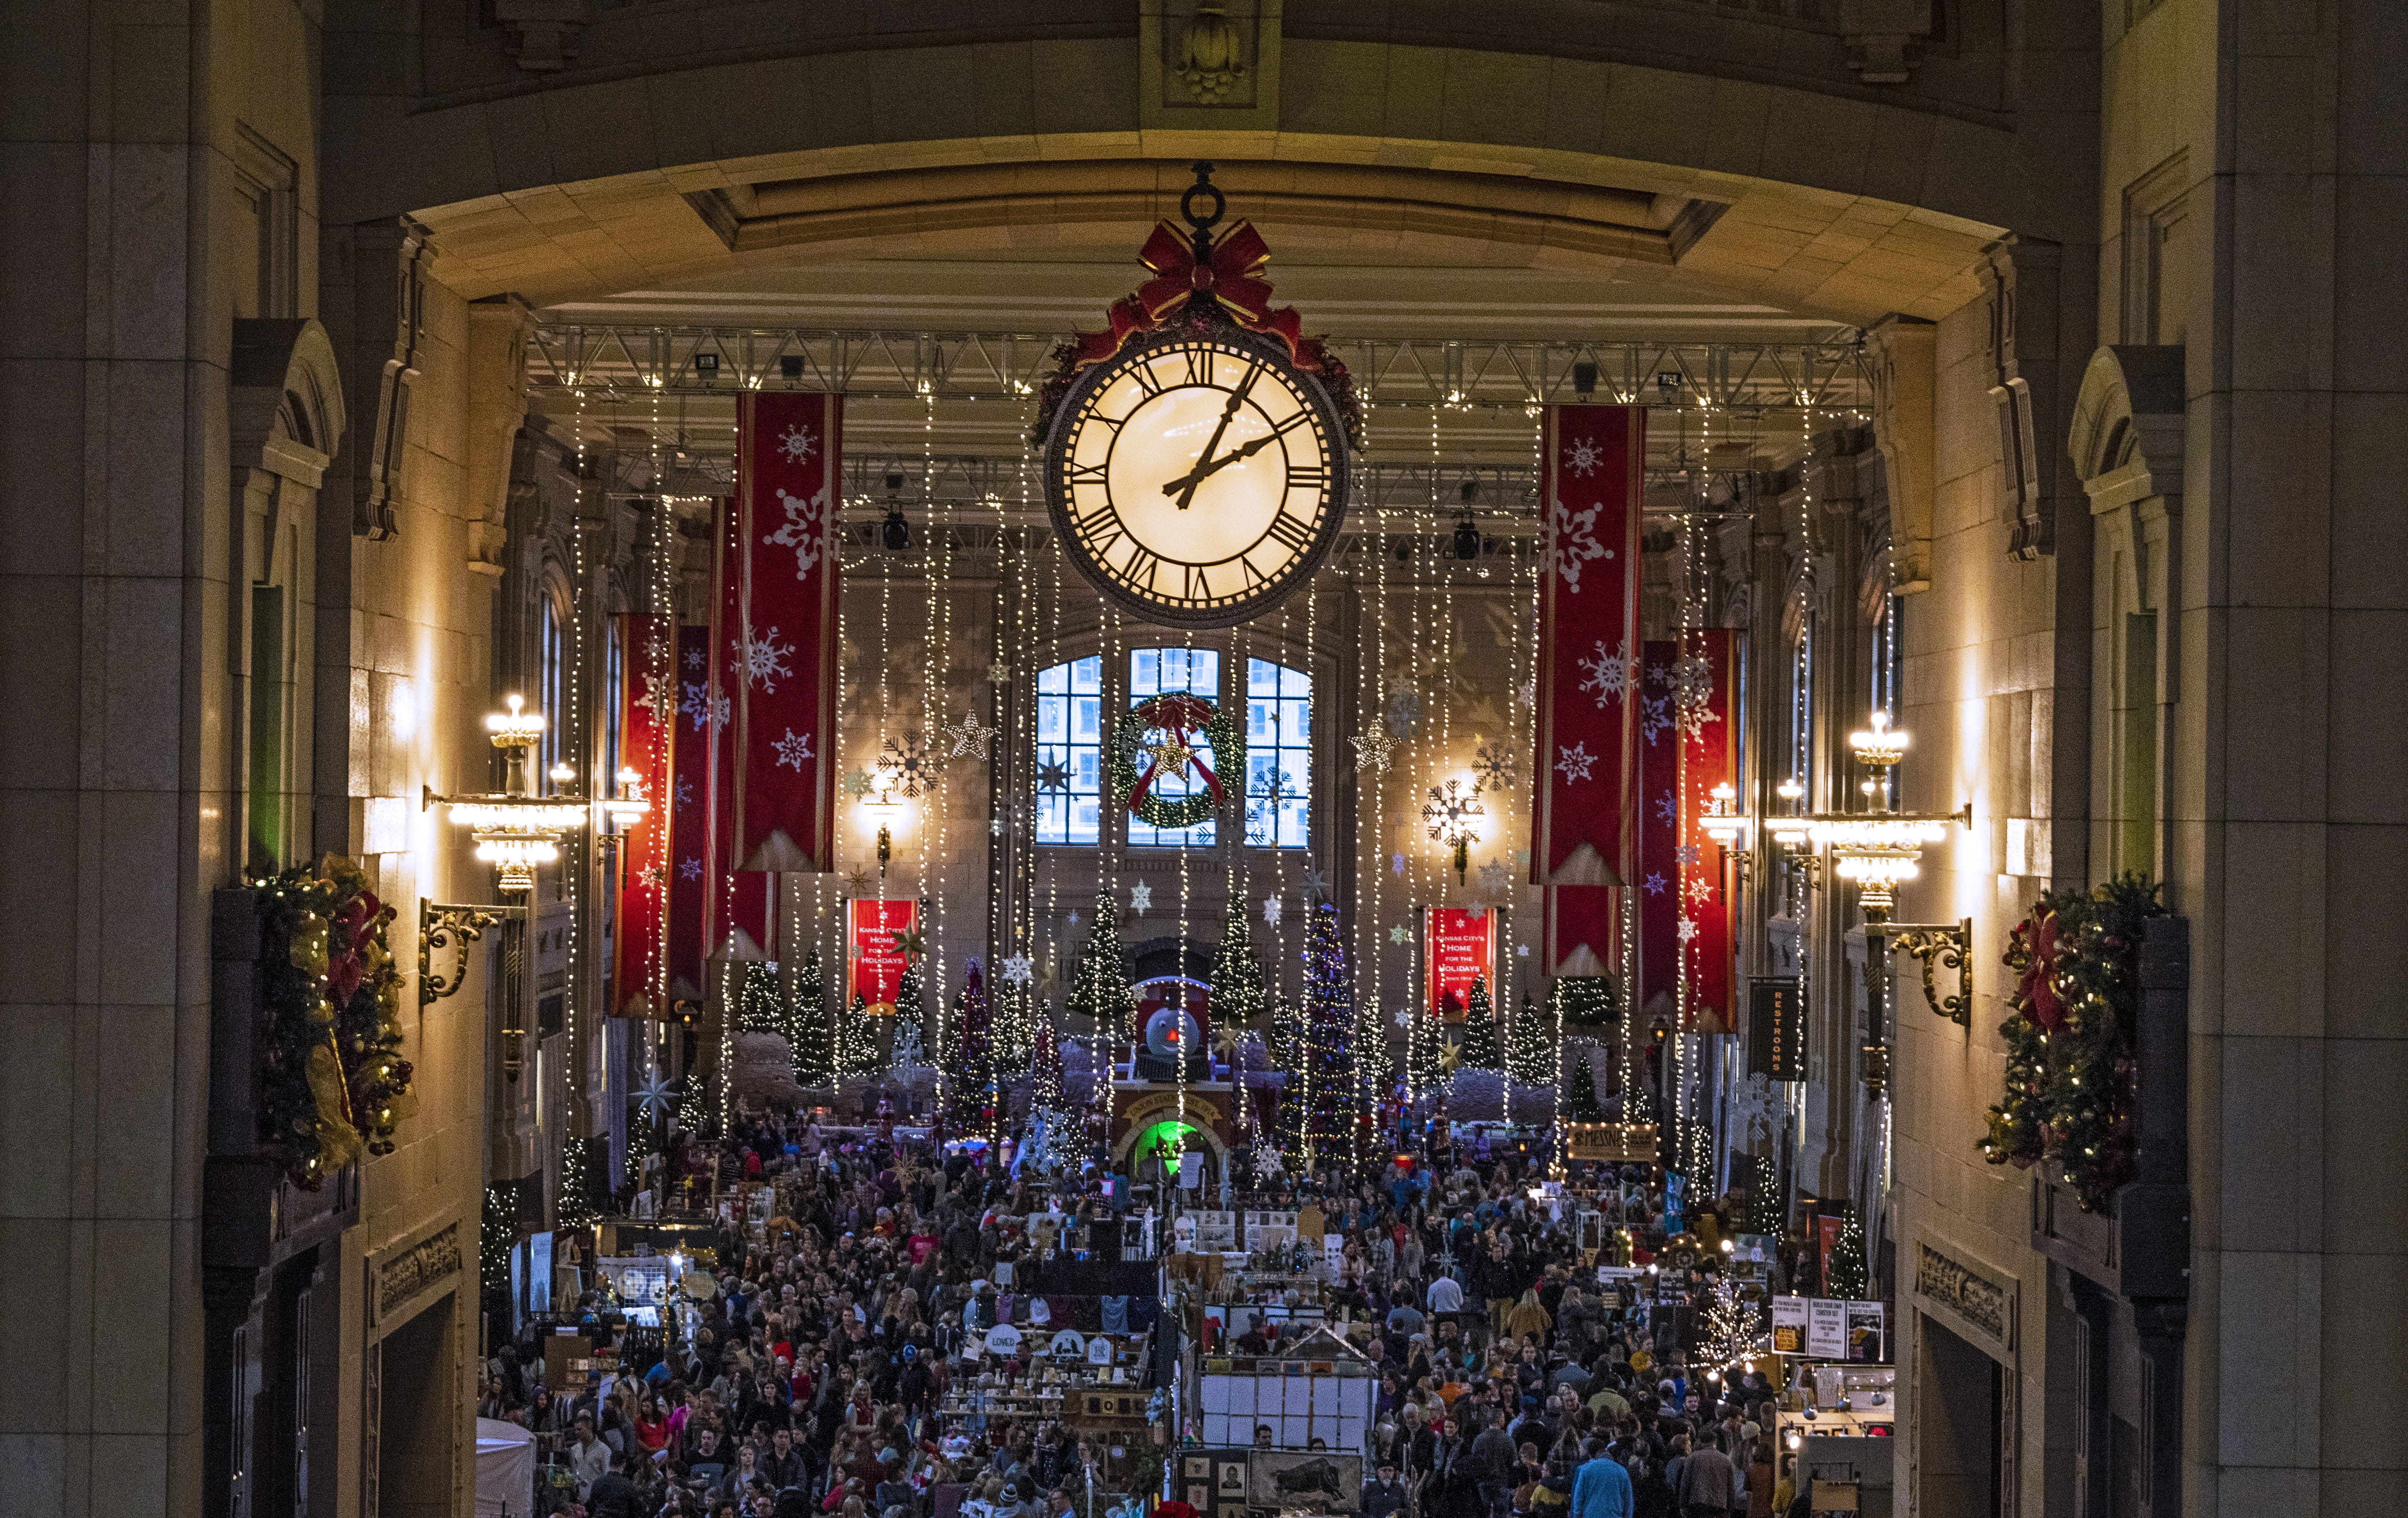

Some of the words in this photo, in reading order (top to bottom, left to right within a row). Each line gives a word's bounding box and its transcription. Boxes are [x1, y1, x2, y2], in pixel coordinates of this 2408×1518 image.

[1128, 361, 1161, 400] XI
[1185, 351, 1213, 385] XII
[1087, 407, 1123, 432] X
[1275, 410, 1309, 432] II
[1072, 463, 1106, 484] IX
[1289, 466, 1323, 488] III
[1080, 508, 1123, 555] VIII
[1268, 511, 1312, 549] IIII
[1122, 548, 1157, 592] VII
[1185, 565, 1211, 600] VI
[1243, 555, 1267, 588] V
[1773, 992, 1782, 1071] RESTROOMS
[1130, 1099, 1153, 1116] UNION
[1154, 1094, 1178, 1103] STATI
[992, 1337, 1014, 1347] LOVED
